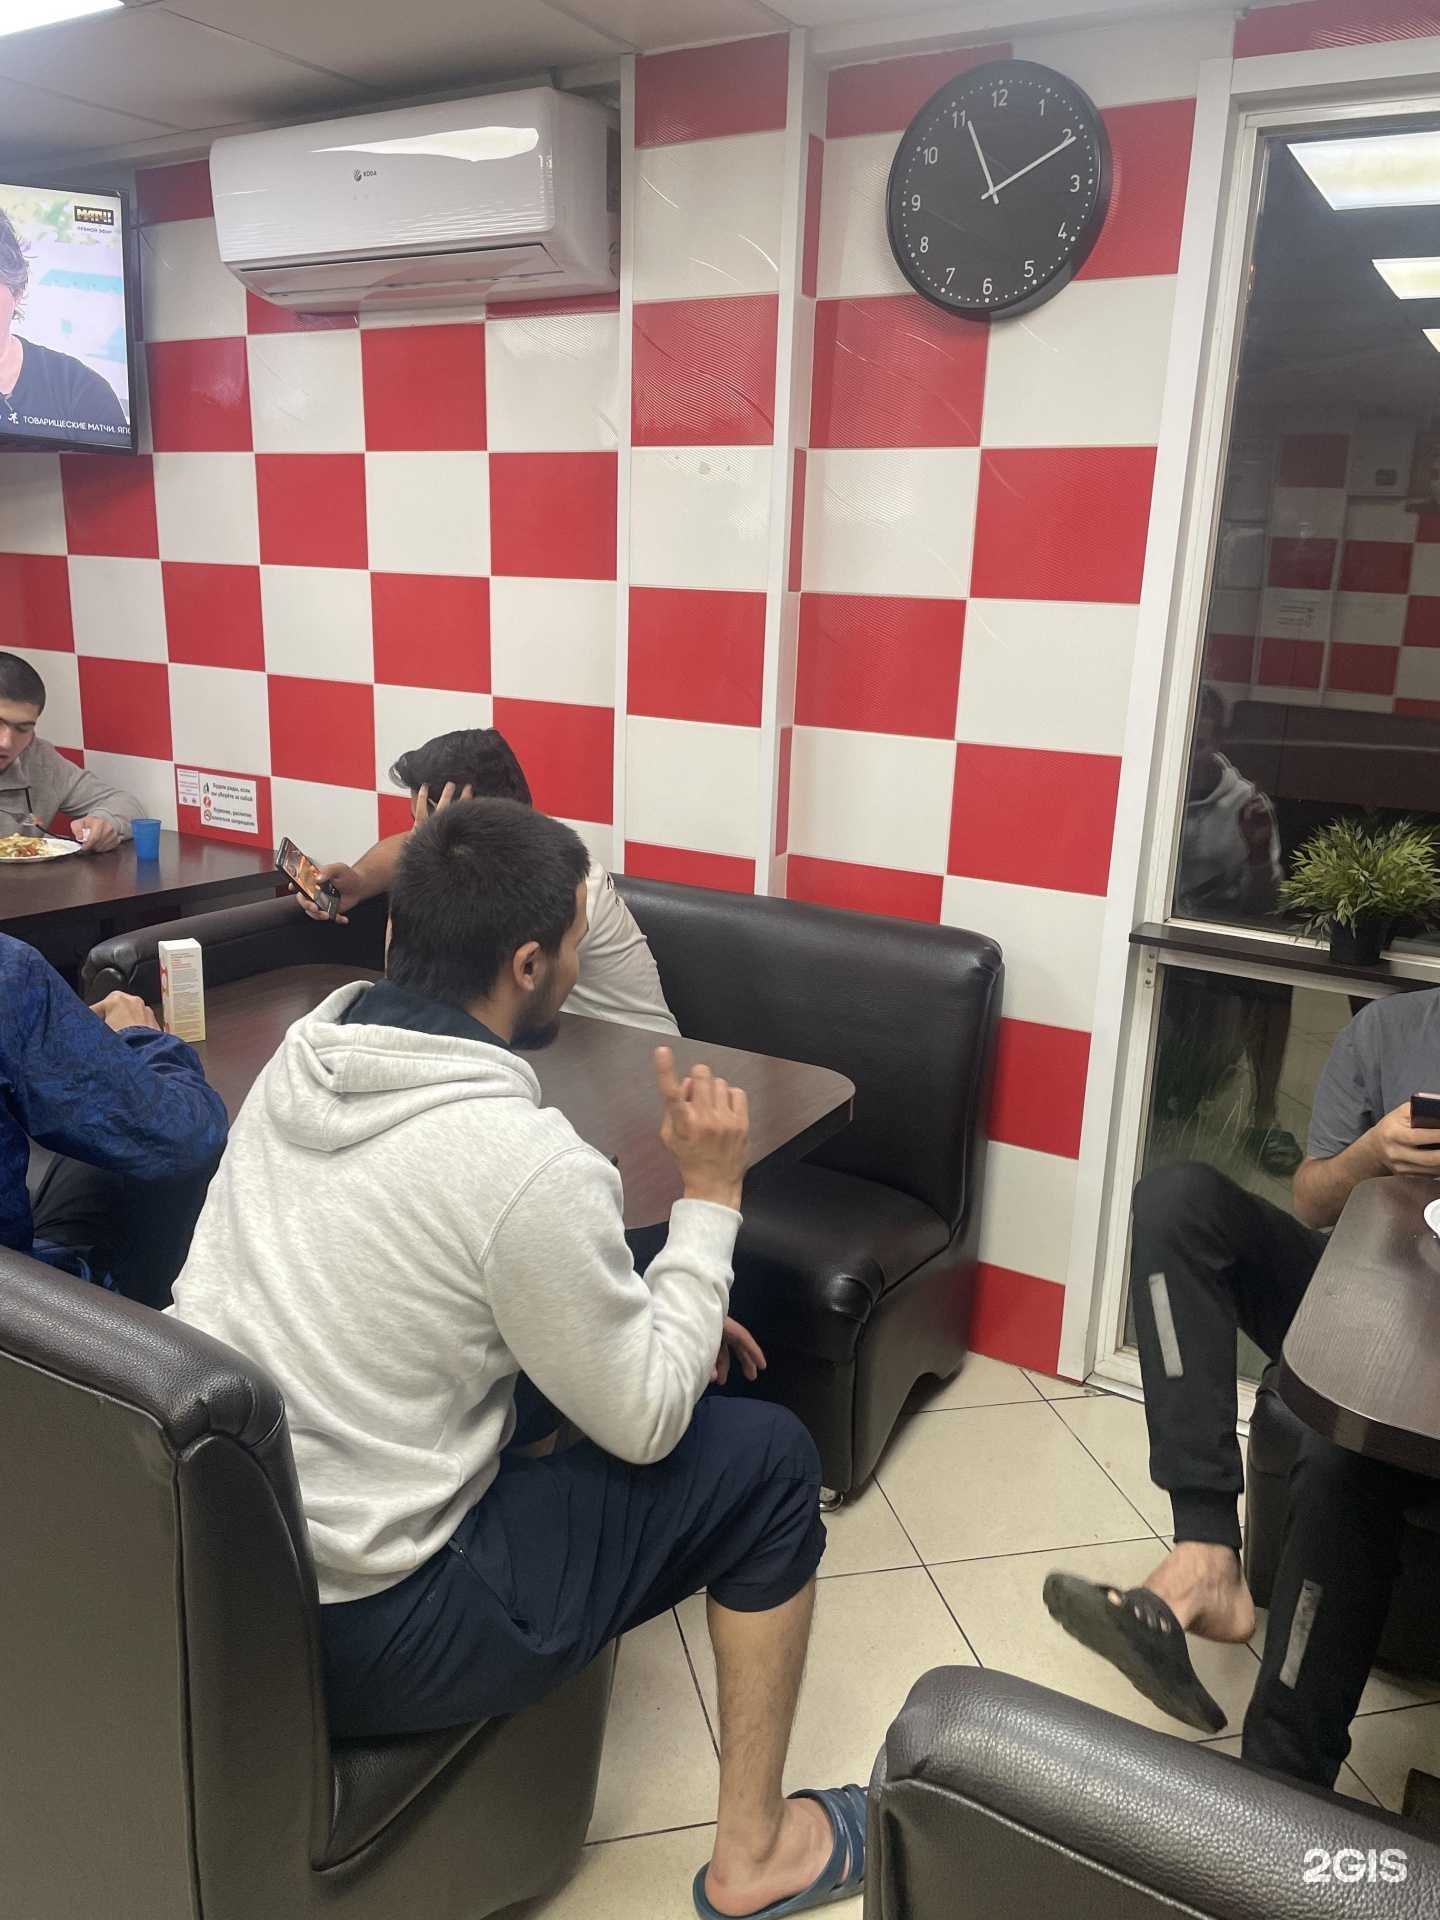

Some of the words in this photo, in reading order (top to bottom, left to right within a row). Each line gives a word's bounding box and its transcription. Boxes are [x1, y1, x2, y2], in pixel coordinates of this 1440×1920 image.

[991, 88, 1009, 109] 12
[1039, 98, 1046, 116] 1
[951, 109, 967, 129] 11
[1061, 127, 1075, 145] 2
[921, 146, 940, 166] 10
[1069, 173, 1081, 193] 3
[911, 194, 921, 211] 9
[1056, 221, 1068, 240] 4
[919, 236, 929, 253] 8
[945, 266, 956, 285] 7
[1023, 259, 1036, 278] 5
[982, 277, 993, 295] 6
[23, 415, 87, 431] ТОВАРИЩЕСКИЕ
